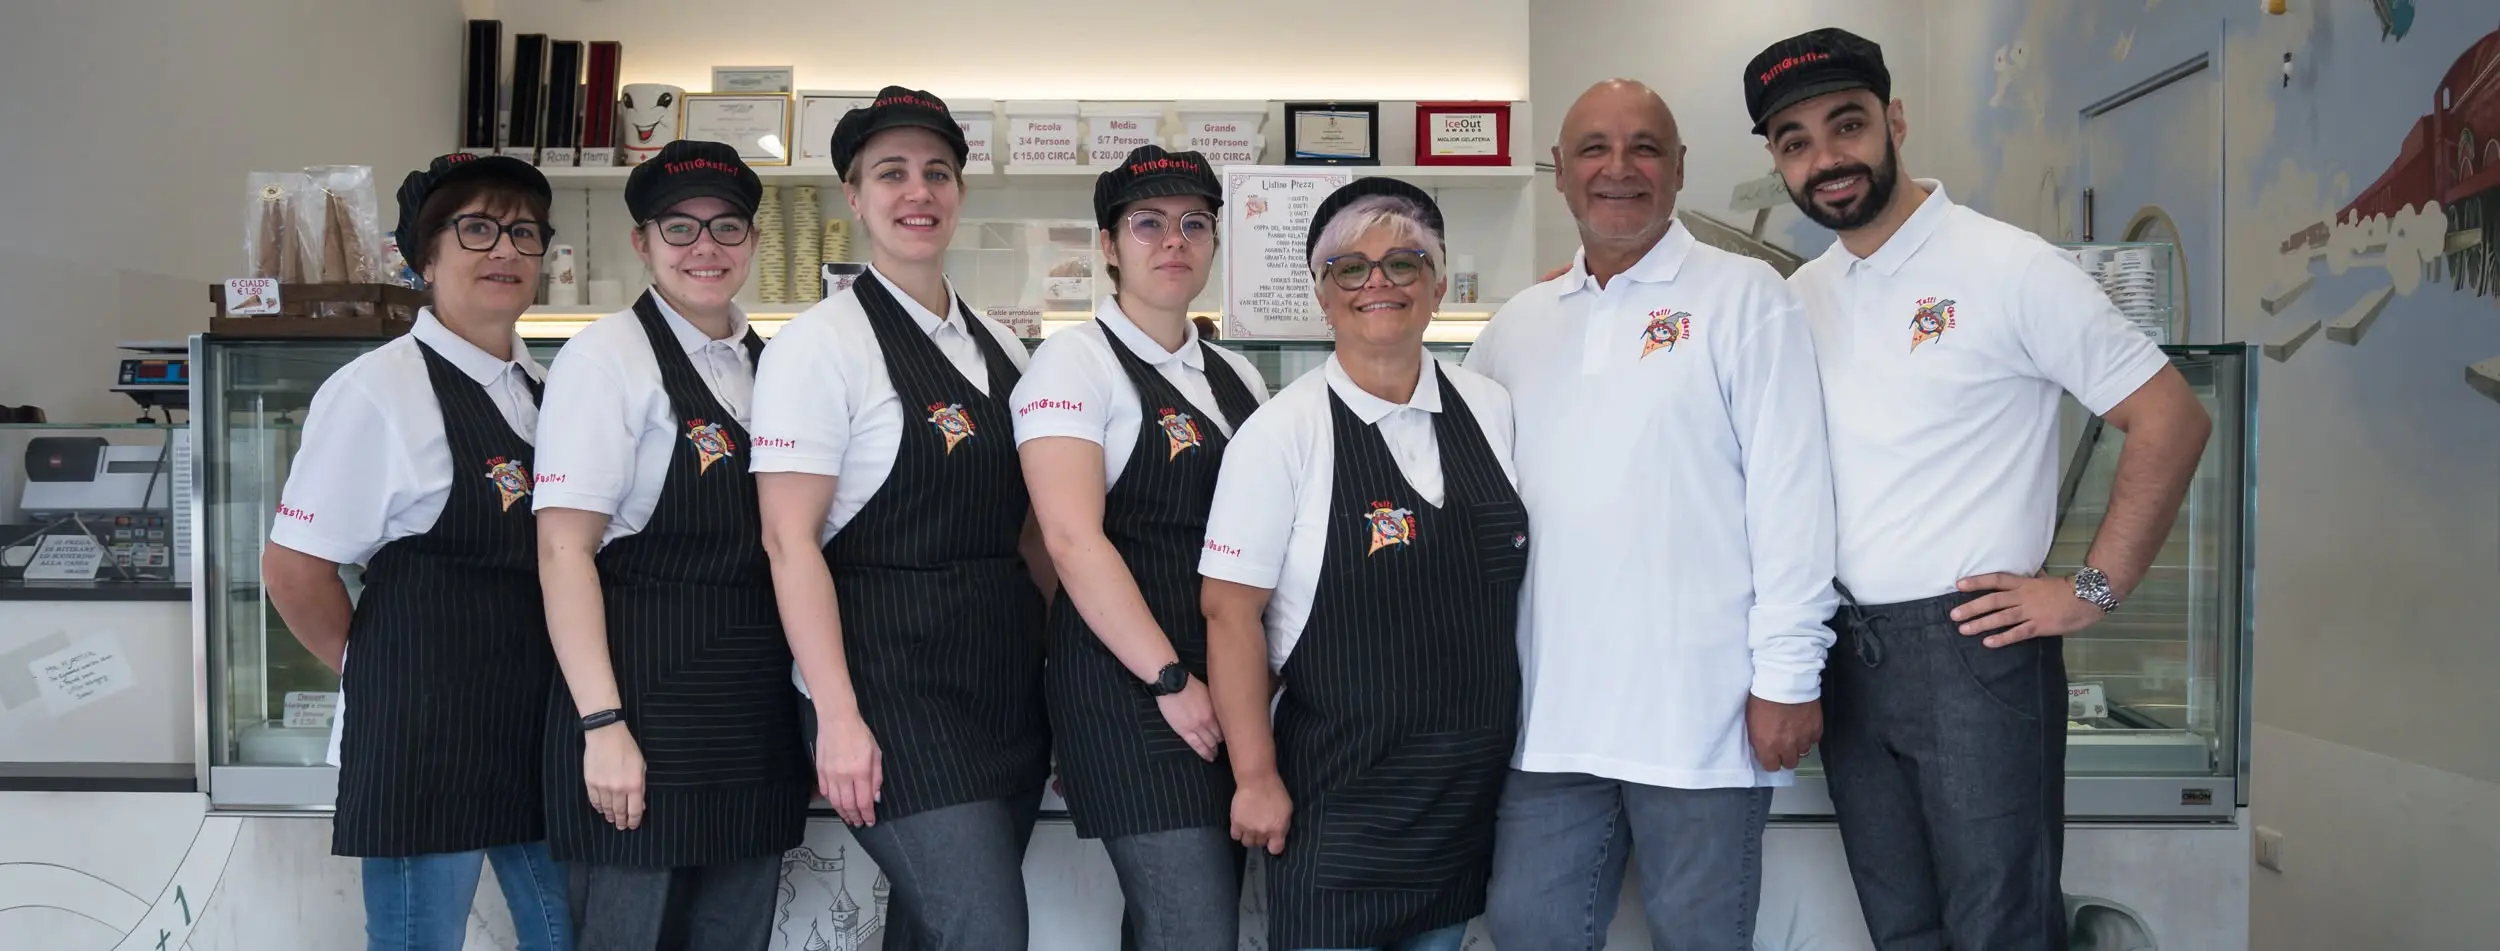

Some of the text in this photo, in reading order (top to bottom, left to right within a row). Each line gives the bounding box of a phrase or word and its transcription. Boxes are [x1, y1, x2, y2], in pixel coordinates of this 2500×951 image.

[1028, 122, 1062, 131] Piccola
[1110, 121, 1137, 130] Media
[1445, 119, 1481, 128] IceOut
[1204, 124, 1236, 133] Grande
[1034, 137, 1070, 146] Persone
[1097, 136, 1149, 145] 5/7 Persone
[1212, 138, 1249, 147] Persone
[546, 151, 571, 162] Ron
[583, 151, 609, 162] Harry
[967, 153, 991, 161] IRCA
[1013, 152, 1076, 161] € 15,00 CIRCA
[1092, 152, 1097, 160] €
[1100, 152, 1124, 160] 20,00
[1222, 152, 1252, 161] CIRCA
[1262, 180, 1287, 190] Listino
[231, 279, 270, 288] 6 CIALDE
[237, 287, 244, 295] €
[1011, 317, 1033, 325] glutine
[2068, 688, 2090, 697] ogurt
[783, 850, 836, 870] OGWARTS
